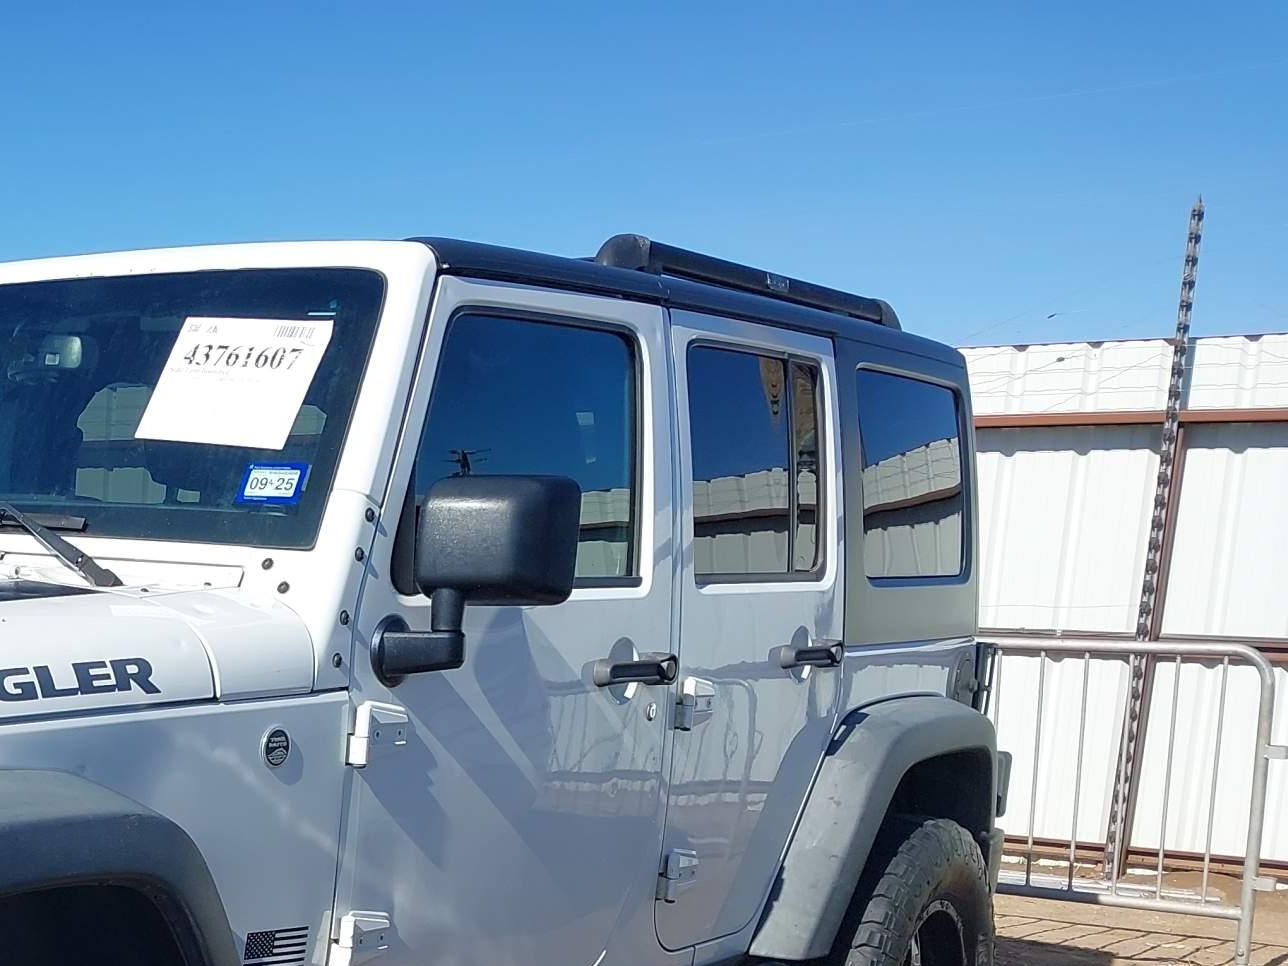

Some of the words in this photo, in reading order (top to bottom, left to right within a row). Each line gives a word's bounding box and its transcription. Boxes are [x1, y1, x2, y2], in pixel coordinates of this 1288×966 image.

[184, 343, 304, 370] 43761607
[249, 476, 269, 491] 09
[275, 477, 295, 491] 25
